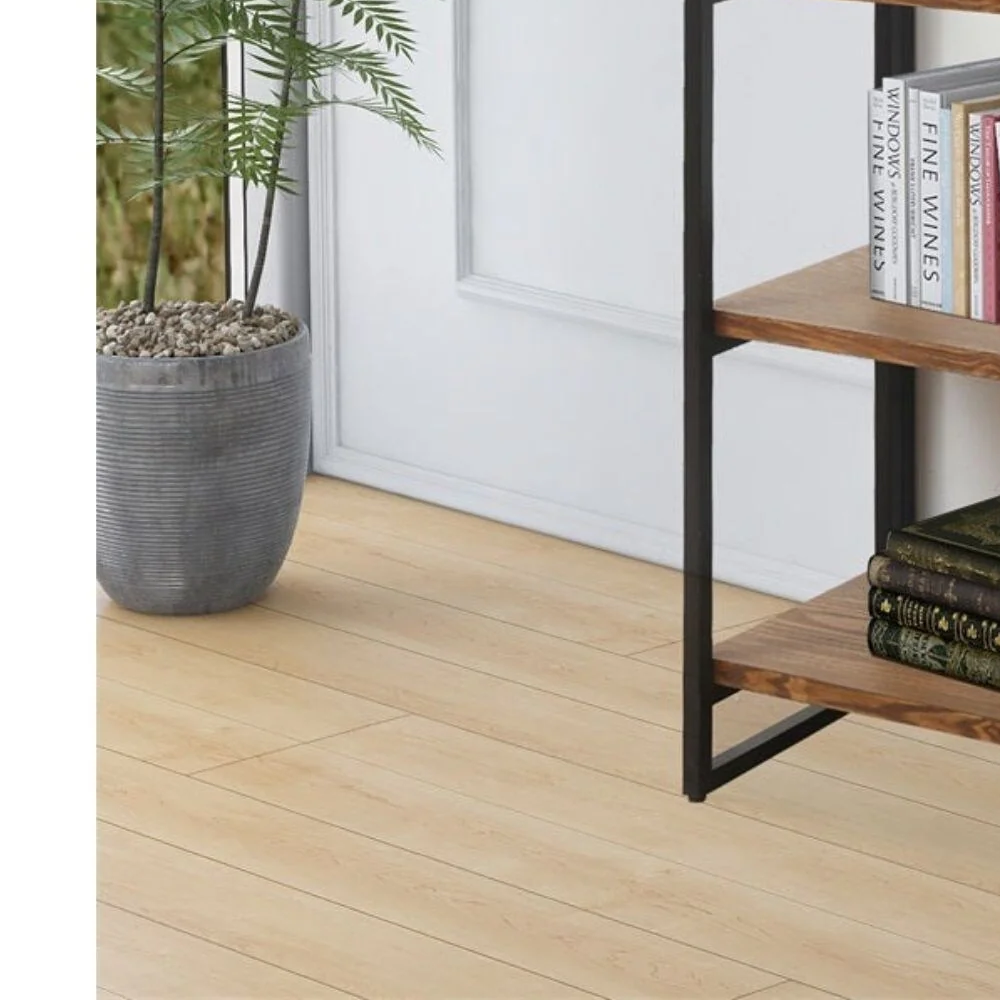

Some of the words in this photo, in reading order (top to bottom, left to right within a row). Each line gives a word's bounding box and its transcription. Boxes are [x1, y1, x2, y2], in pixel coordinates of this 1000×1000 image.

[887, 87, 902, 180] WINDOWS
[922, 121, 939, 182] FINE
[969, 123, 982, 207] WINDOWS
[923, 194, 940, 283] WINES
